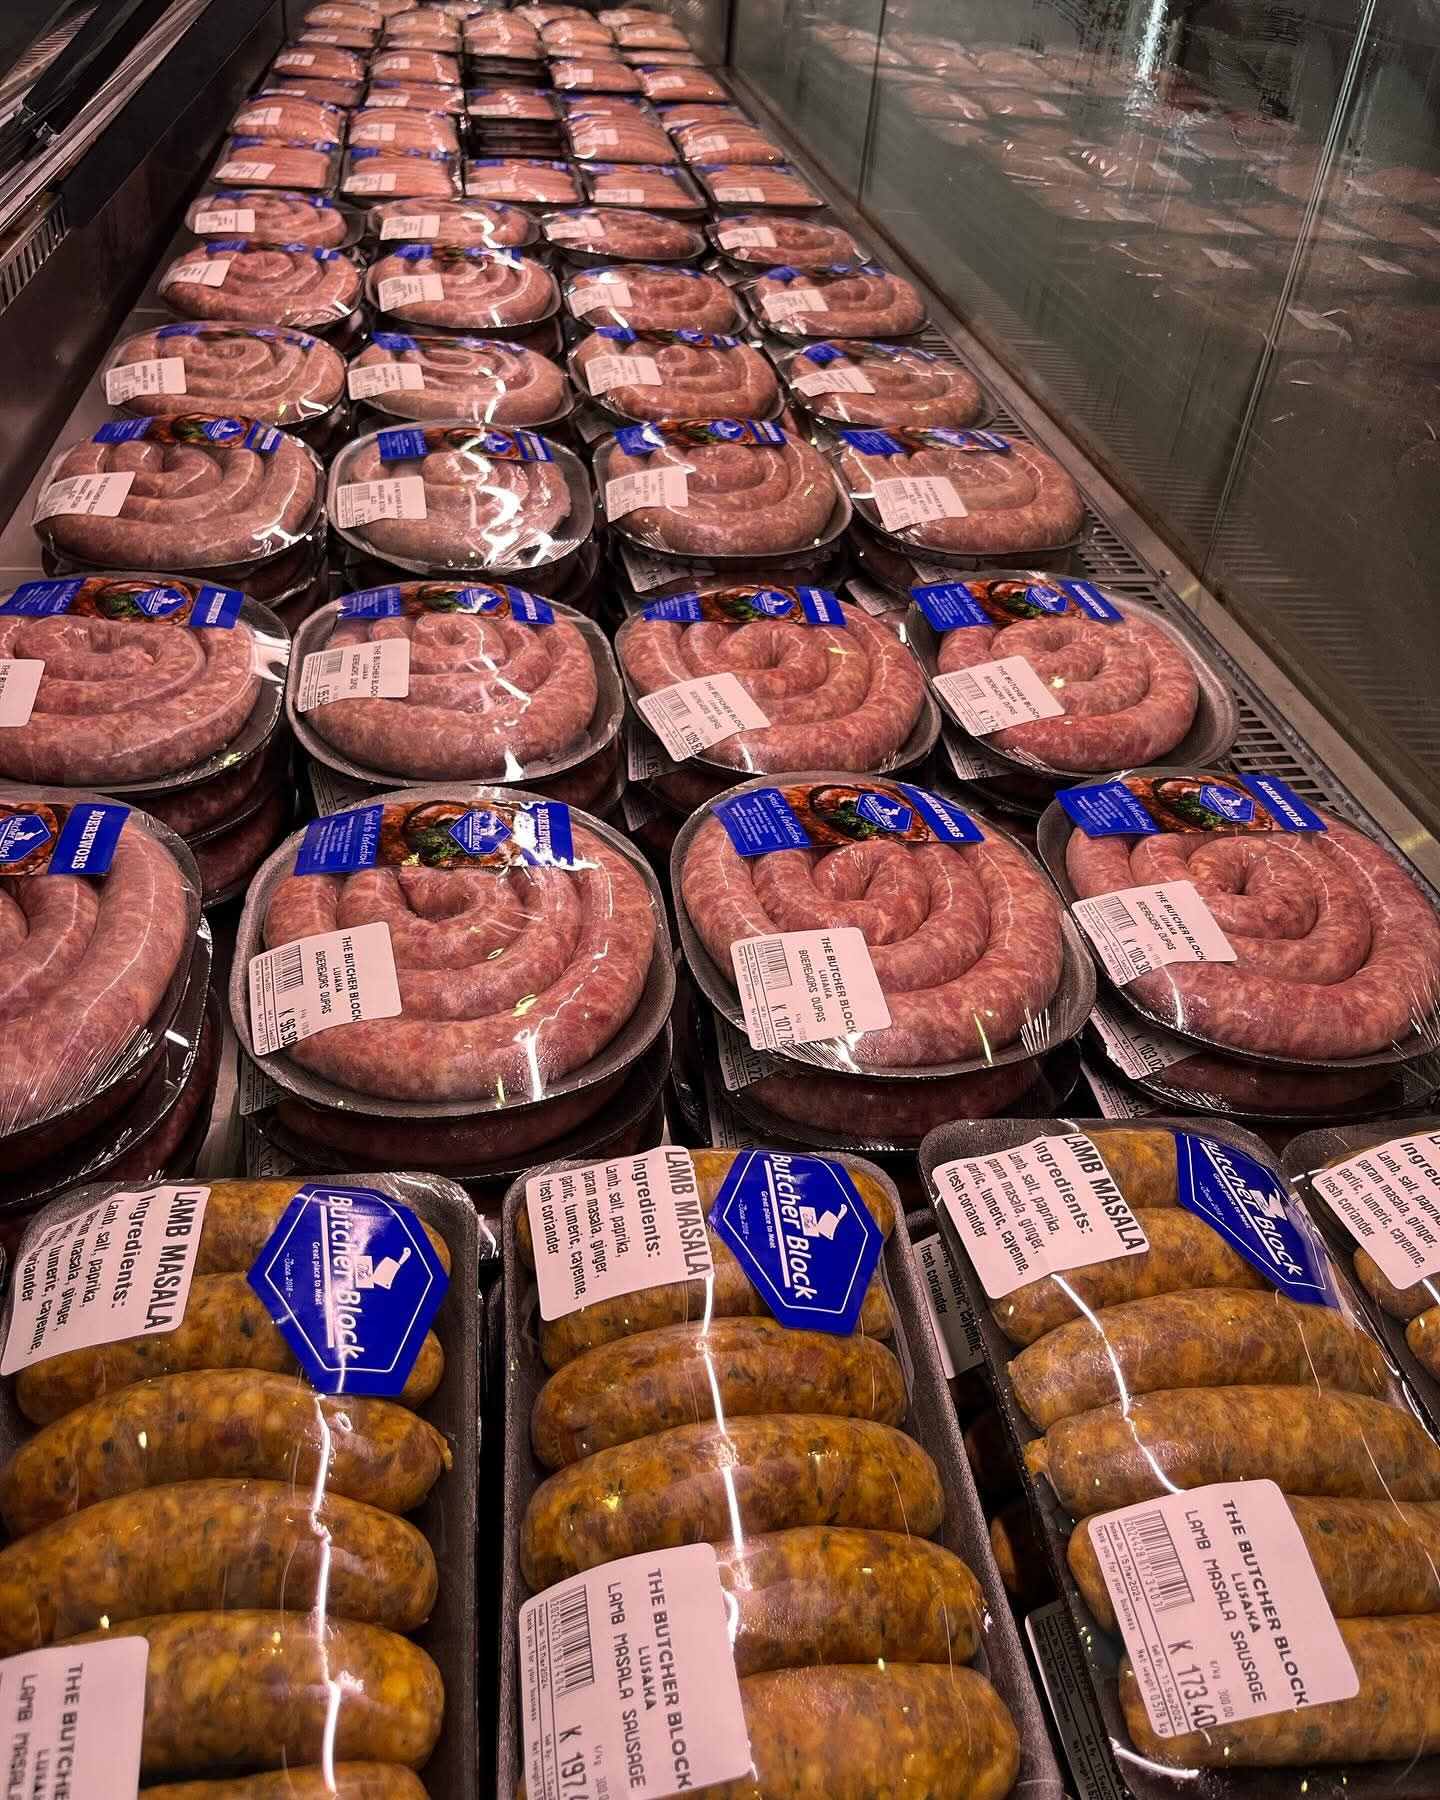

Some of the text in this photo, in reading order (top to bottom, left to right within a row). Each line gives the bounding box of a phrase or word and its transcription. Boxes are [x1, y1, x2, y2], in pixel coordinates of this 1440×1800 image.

[71, 810, 107, 870] BOEREWORS
[1122, 938, 1153, 977] K 100.30
[1155, 890, 1207, 961] THE BUTCHER BLOCK
[278, 1008, 295, 1019] K
[315, 950, 332, 1015] BOEREWORS OUPAS
[342, 936, 363, 1022] THE BUTCHER BLOCK
[798, 949, 826, 1024] BOEREWORS OUPAS
[821, 936, 857, 1034] THE BUTCHER BLOCK
[279, 1018, 299, 1048] 96.90
[771, 1003, 797, 1048] K 107.78
[1131, 1033, 1166, 1073] K 103.02
[632, 1158, 661, 1258] Ingredients:
[761, 1191, 769, 1208] Great
[945, 1167, 987, 1238] fresh coriander
[985, 1158, 1045, 1254] garam masala, ginger,
[1008, 1152, 1060, 1235] Lamb, salt, paprika,
[1033, 1141, 1093, 1234] Ingredients:
[1062, 1135, 1145, 1250] LAMB MASALA
[1199, 1137, 1303, 1277] Butcher Block
[1223, 1190, 1236, 1206] place
[1321, 1177, 1375, 1238] fresh coriander
[1356, 1159, 1438, 1248] garam masala, ginger,
[1376, 1151, 1419, 1195] Lamb, salt,
[540, 1180, 559, 1254] fresh coriander
[559, 1176, 587, 1299] garlic, tumeric, cayenne,
[581, 1170, 608, 1278] garam masala, ginger,
[606, 1164, 631, 1258] Lamb, salt, paprika,
[665, 1151, 711, 1276] LAMB MASALA
[763, 1209, 772, 1225] place
[767, 1226, 773, 1234] to
[770, 1154, 817, 1300] Butcher Block
[964, 1163, 1029, 1276] garlic, tumeric, cayenne,
[1337, 1168, 1426, 1269] garlic, tumeric, cayenne,
[65, 1238, 85, 1285] masala,
[113, 1195, 156, 1308] Ingredients:
[144, 1191, 200, 1329] LAMB MASALA
[312, 1241, 320, 1263] Great
[313, 1264, 321, 1280] place
[329, 1195, 366, 1360] Butcher Block
[920, 1244, 948, 1314] fresh coriander
[27, 1245, 64, 1354] tumeric, cayenne,
[54, 1288, 76, 1331] ginger,
[315, 1287, 323, 1305] Meat
[1095, 1525, 1136, 1631] Thank you for your business
[1184, 1509, 1268, 1704] LAMB MASALA SAUSAGE
[1222, 1500, 1309, 1705] THE BUTCHER BLOCK
[1231, 1572, 1261, 1634] LUSAKA
[64, 1662, 84, 1705] THE
[608, 1582, 646, 1789] LAMB MASALA SAUSAGE
[638, 1645, 657, 1711] LUSAKA
[648, 1568, 693, 1790] THE BUTCHER BLOCK
[1167, 1640, 1218, 1729] K 173.40
[559, 1725, 583, 1744] K
[1159, 1722, 1170, 1734] kg
